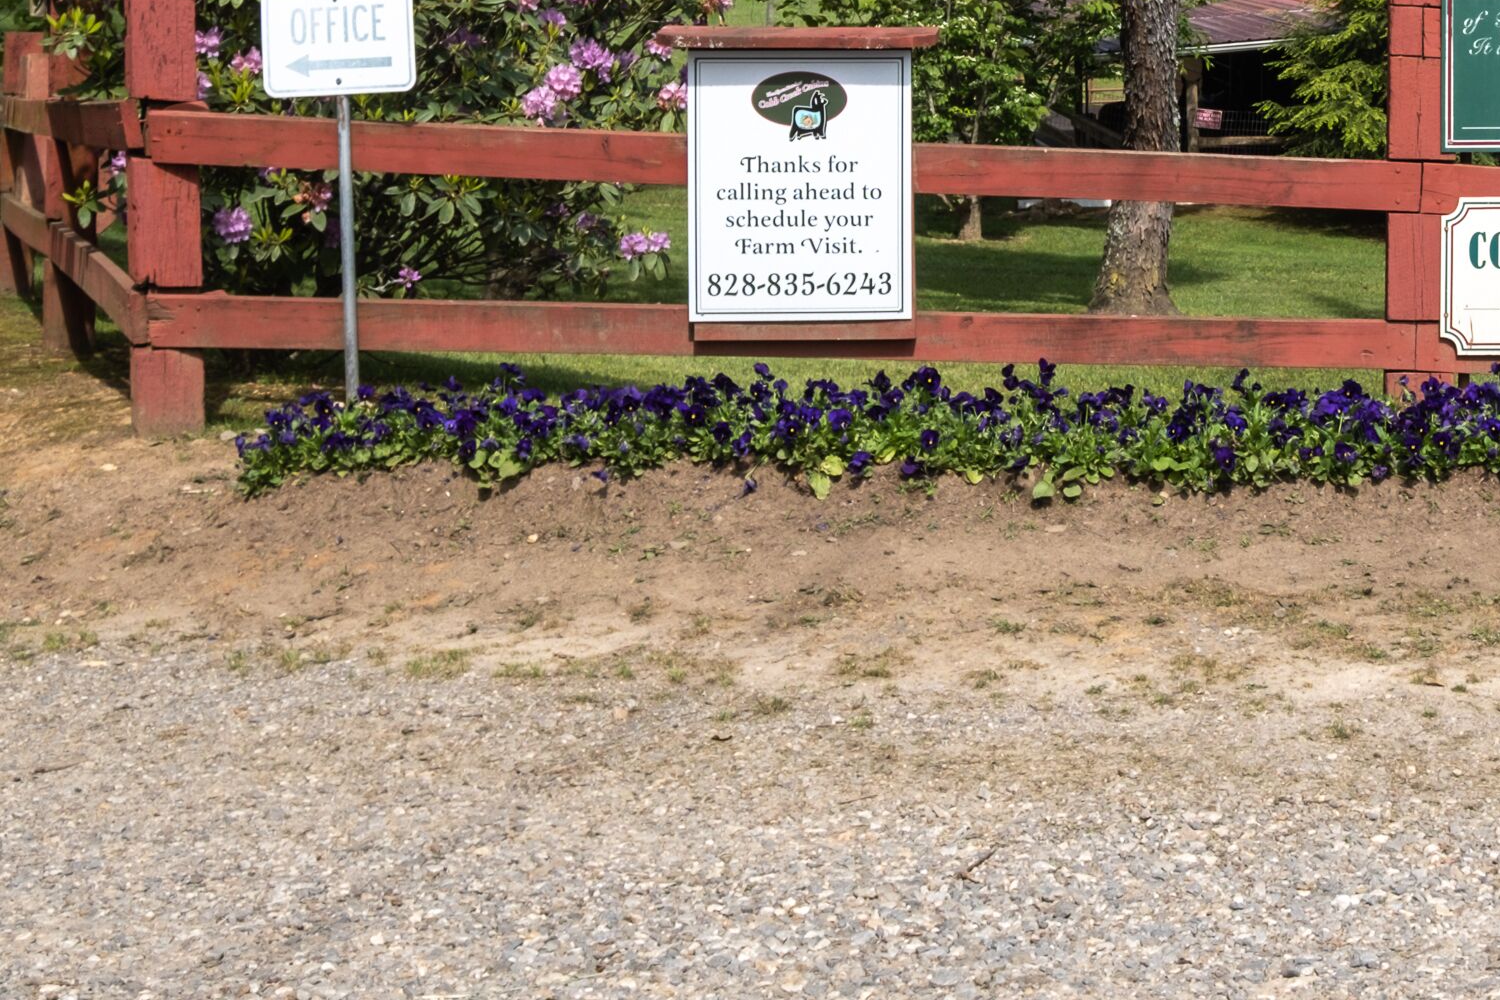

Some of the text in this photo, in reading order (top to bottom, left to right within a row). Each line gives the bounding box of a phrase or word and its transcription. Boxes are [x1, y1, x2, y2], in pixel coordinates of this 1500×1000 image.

[290, 4, 386, 45] OFFICE
[1462, 10, 1488, 34] of
[1468, 37, 1493, 55] It
[740, 155, 858, 173] Thanks for
[716, 182, 882, 205] calling ahead to
[725, 209, 873, 232] schedule your
[734, 237, 863, 254] Farm Visit.
[707, 272, 892, 296] 828-835-6243
